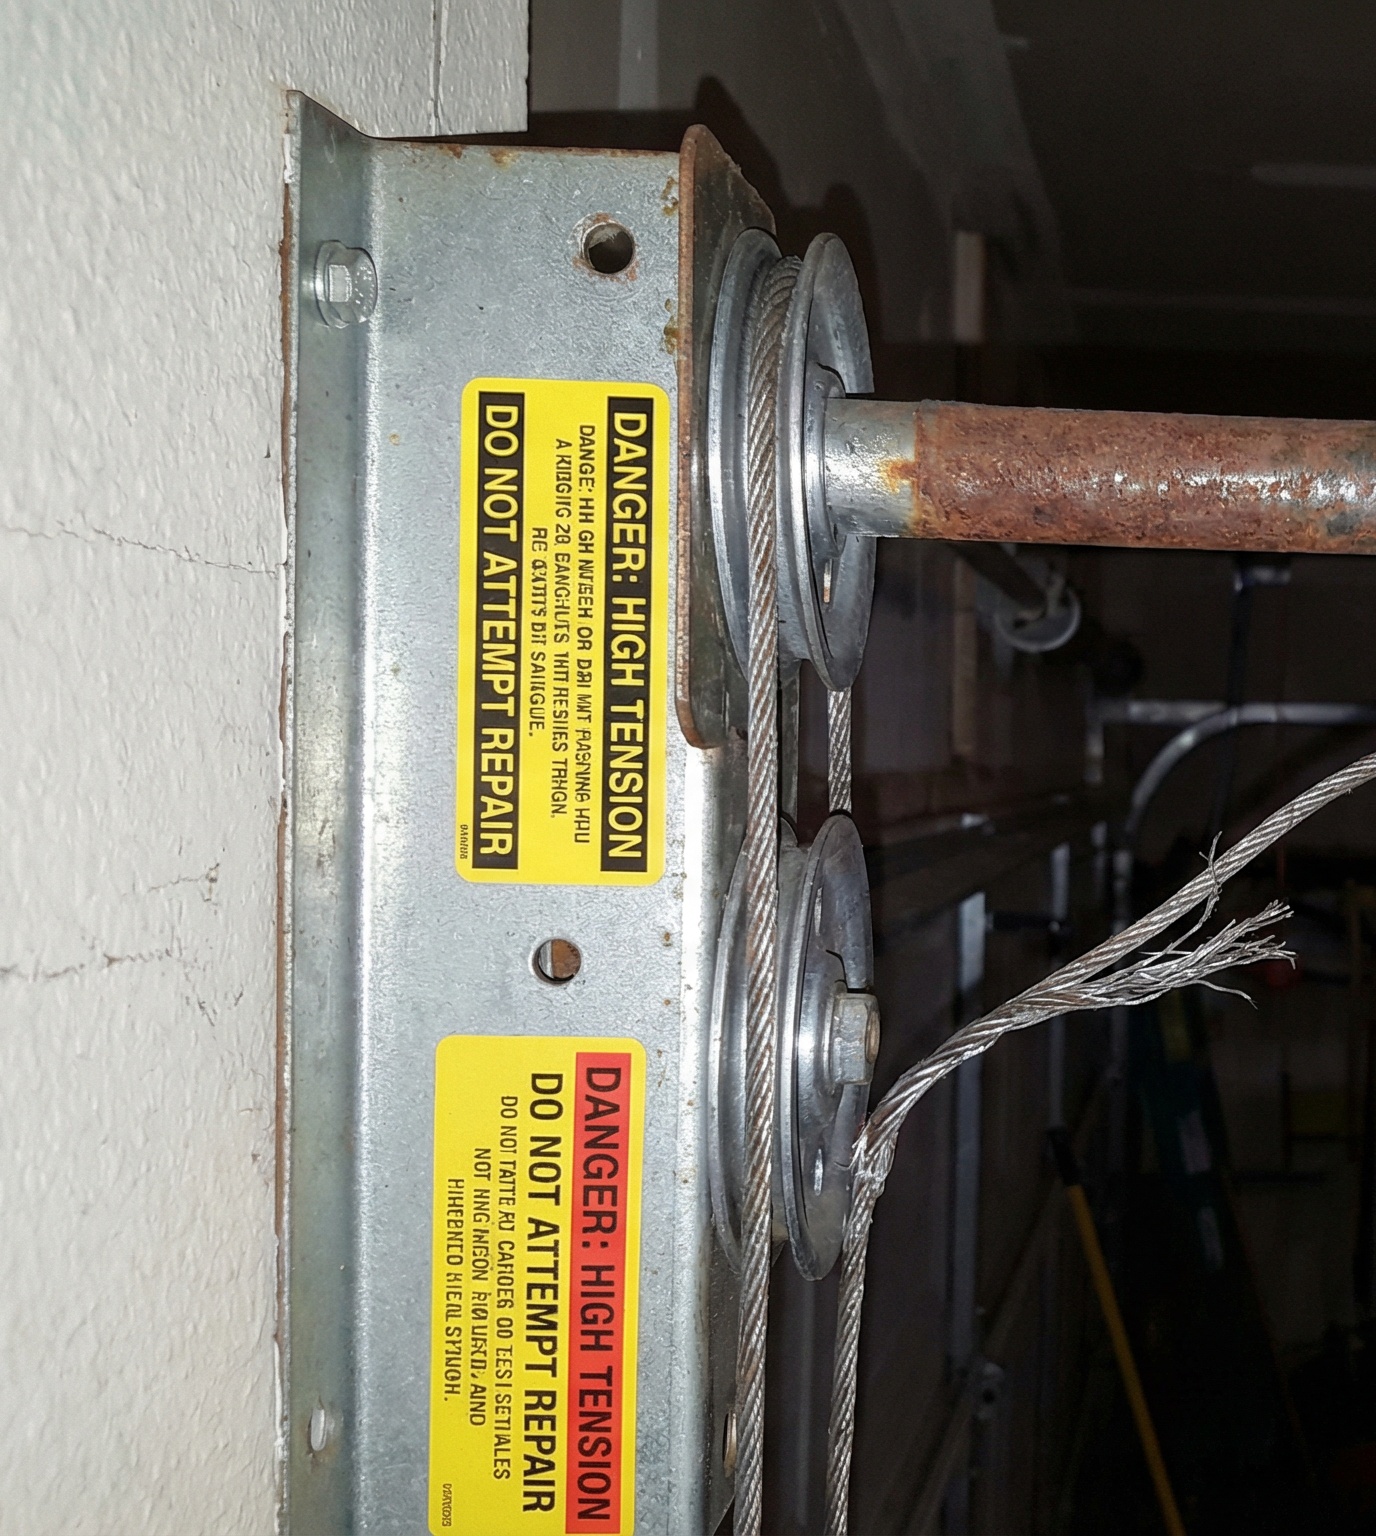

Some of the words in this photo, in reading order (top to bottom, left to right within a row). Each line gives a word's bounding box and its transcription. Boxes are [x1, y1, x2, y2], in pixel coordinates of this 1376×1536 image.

[483, 404, 518, 457] DO
[483, 468, 517, 541] NOT
[612, 412, 647, 583] DANGER:
[482, 552, 516, 719] ATTEMPT
[610, 596, 645, 684] HIGH
[480, 728, 513, 856] REPAIR
[608, 700, 644, 858] TENSION
[501, 1096, 518, 1118] DO
[529, 1072, 563, 1121] DO
[474, 1148, 491, 1181] NOT
[527, 1135, 560, 1205] NOT
[581, 1067, 620, 1249] DANGER:
[525, 1217, 559, 1377] ATTEMPT
[580, 1265, 614, 1352] HIGH
[522, 1389, 555, 1513] REPAIR
[577, 1367, 612, 1521] TENSION
